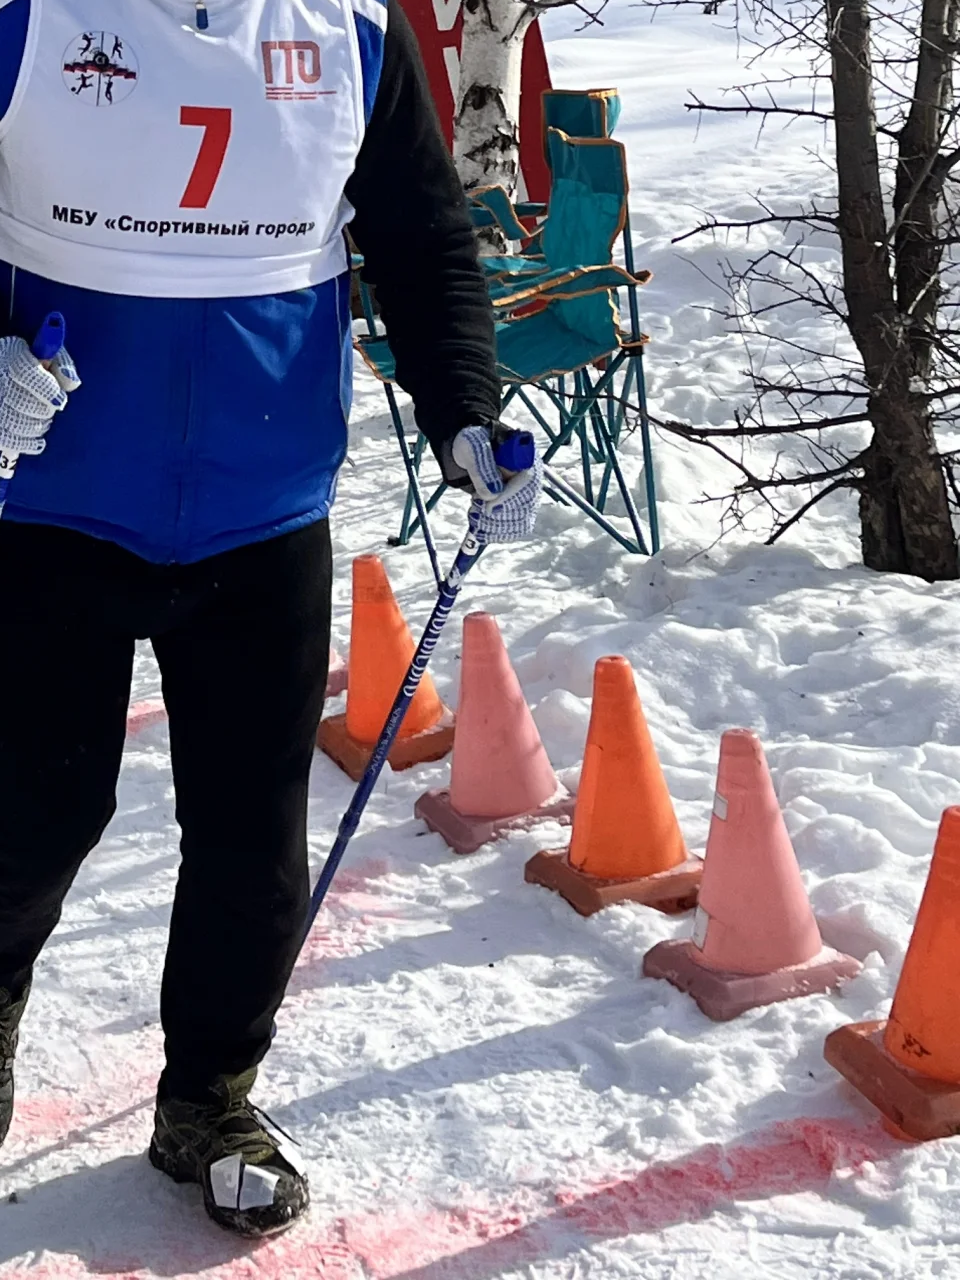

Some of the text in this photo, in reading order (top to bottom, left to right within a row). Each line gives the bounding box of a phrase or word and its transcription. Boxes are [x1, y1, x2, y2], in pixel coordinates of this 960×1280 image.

[261, 40, 322, 85] ГТО
[179, 105, 232, 209] 7
[52, 204, 316, 238] МБУ «Спортивный город»
